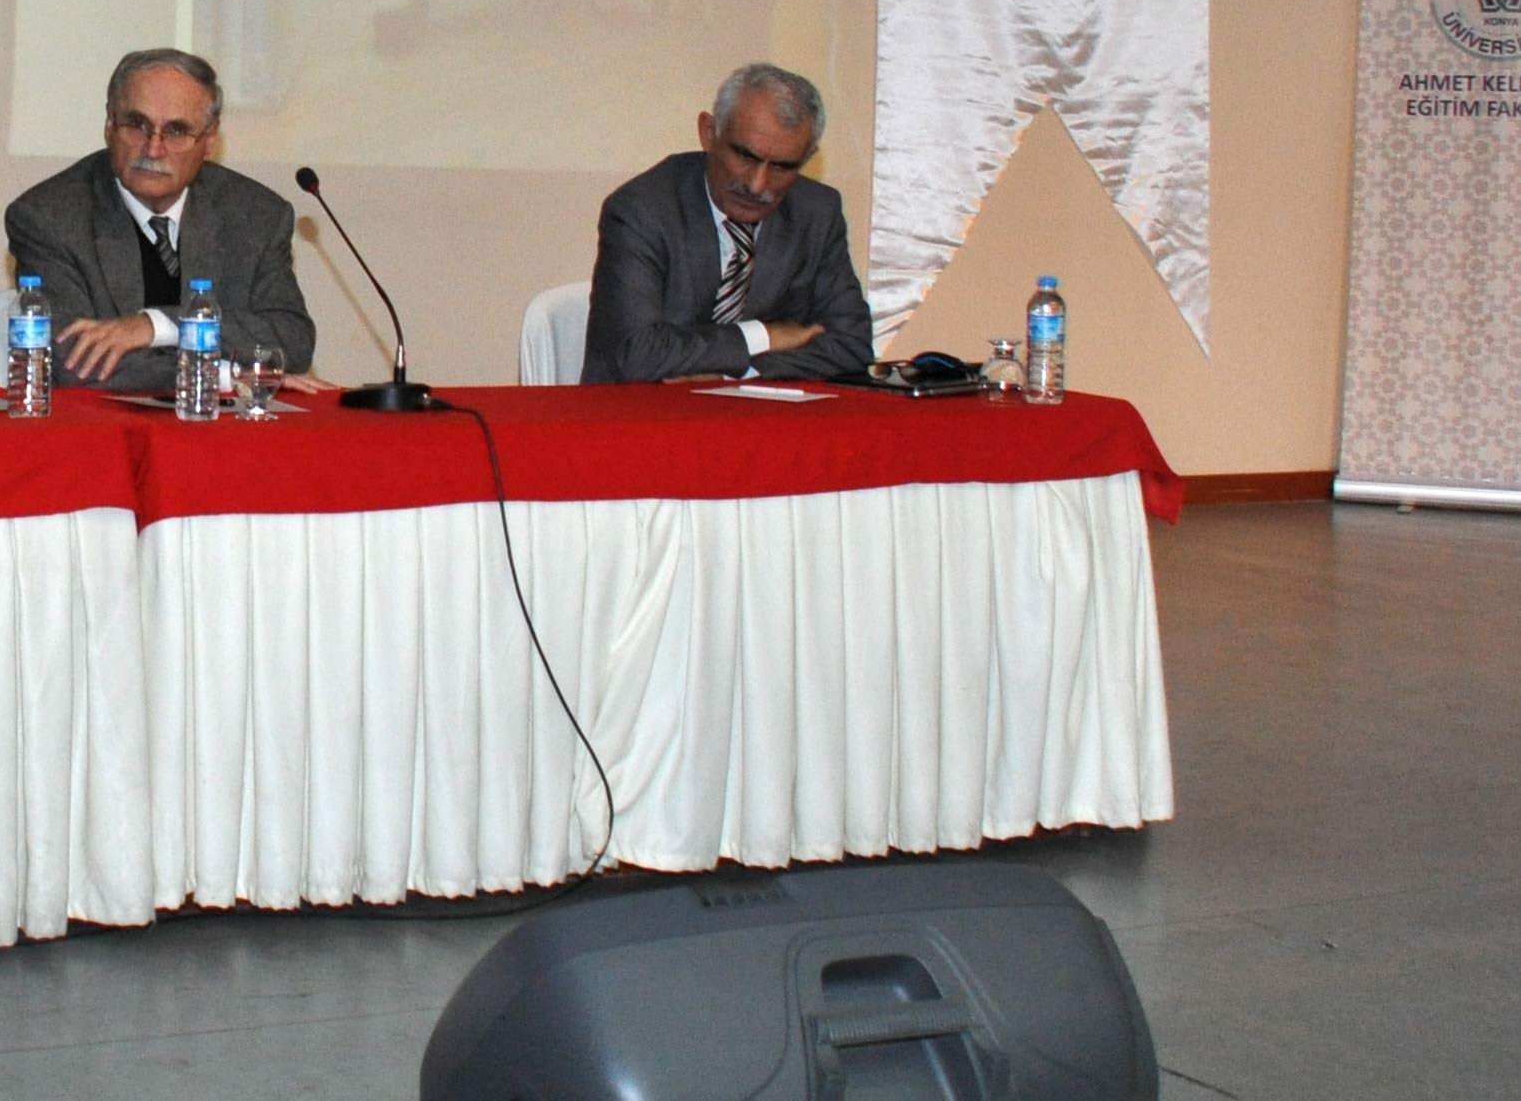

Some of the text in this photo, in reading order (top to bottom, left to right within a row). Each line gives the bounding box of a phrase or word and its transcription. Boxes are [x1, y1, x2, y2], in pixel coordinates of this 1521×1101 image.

[1399, 74, 1521, 92] AHMET KEL
[1406, 95, 1480, 117] EĞİTİM
